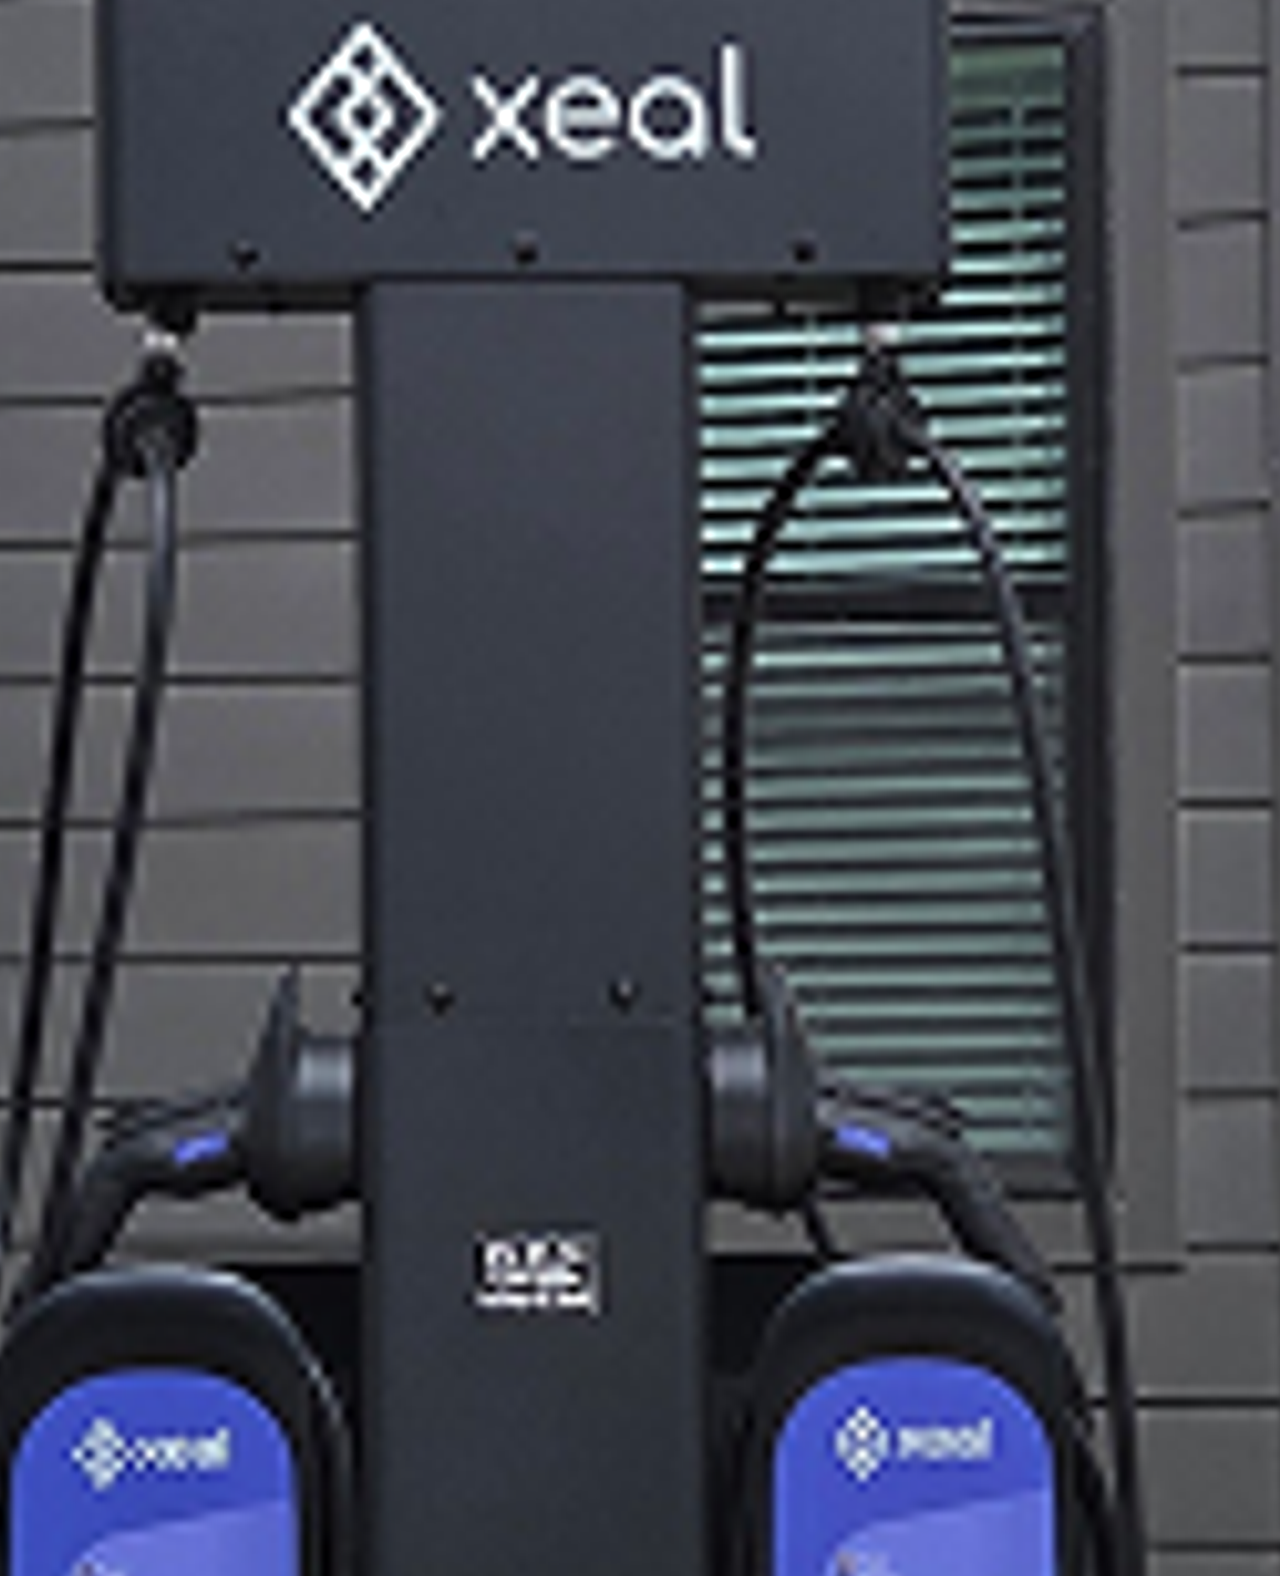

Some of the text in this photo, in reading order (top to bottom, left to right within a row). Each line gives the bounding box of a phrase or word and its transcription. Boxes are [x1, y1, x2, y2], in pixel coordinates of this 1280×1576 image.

[472, 44, 757, 160] xeal
[126, 1426, 230, 1471] xeal
[898, 1417, 993, 1461] xeal
